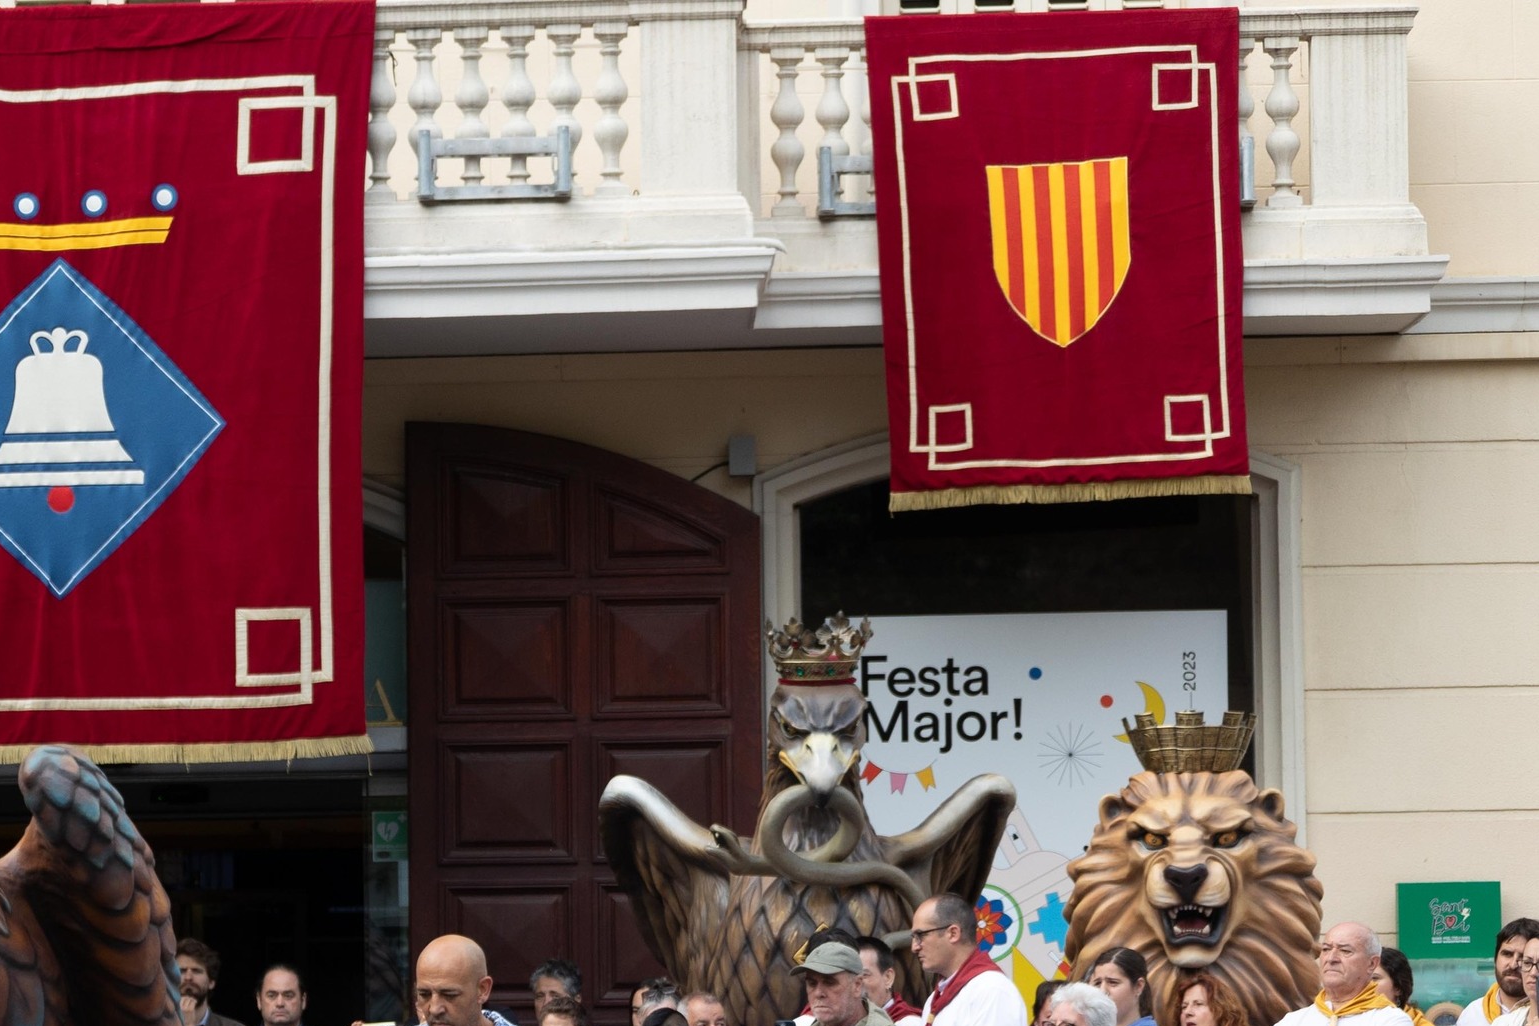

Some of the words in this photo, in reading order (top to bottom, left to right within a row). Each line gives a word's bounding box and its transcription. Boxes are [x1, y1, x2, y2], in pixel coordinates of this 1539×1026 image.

[861, 655, 989, 698] Festa
[1182, 651, 1196, 691] 2023
[862, 698, 1023, 754] Major!
